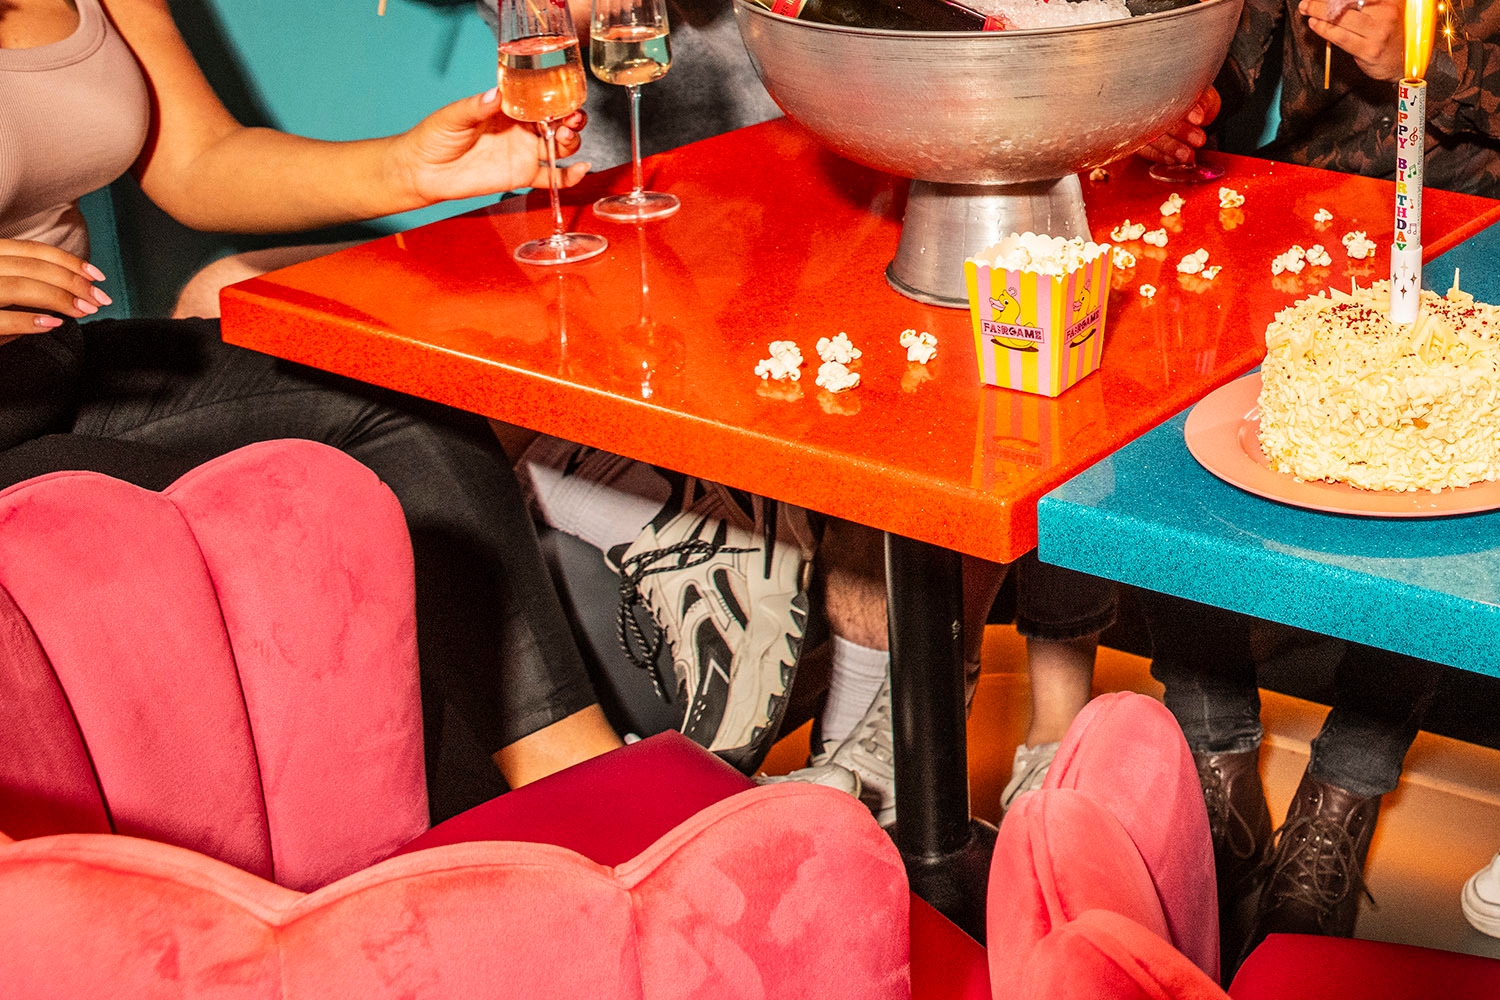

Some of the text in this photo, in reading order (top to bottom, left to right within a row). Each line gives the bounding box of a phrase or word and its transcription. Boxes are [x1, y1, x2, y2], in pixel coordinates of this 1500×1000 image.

[1395, 86, 1409, 251] HAPPY BIRTHDAY
[983, 322, 1042, 340] FAIRGAME
[1065, 311, 1100, 341] FAIRGAME
